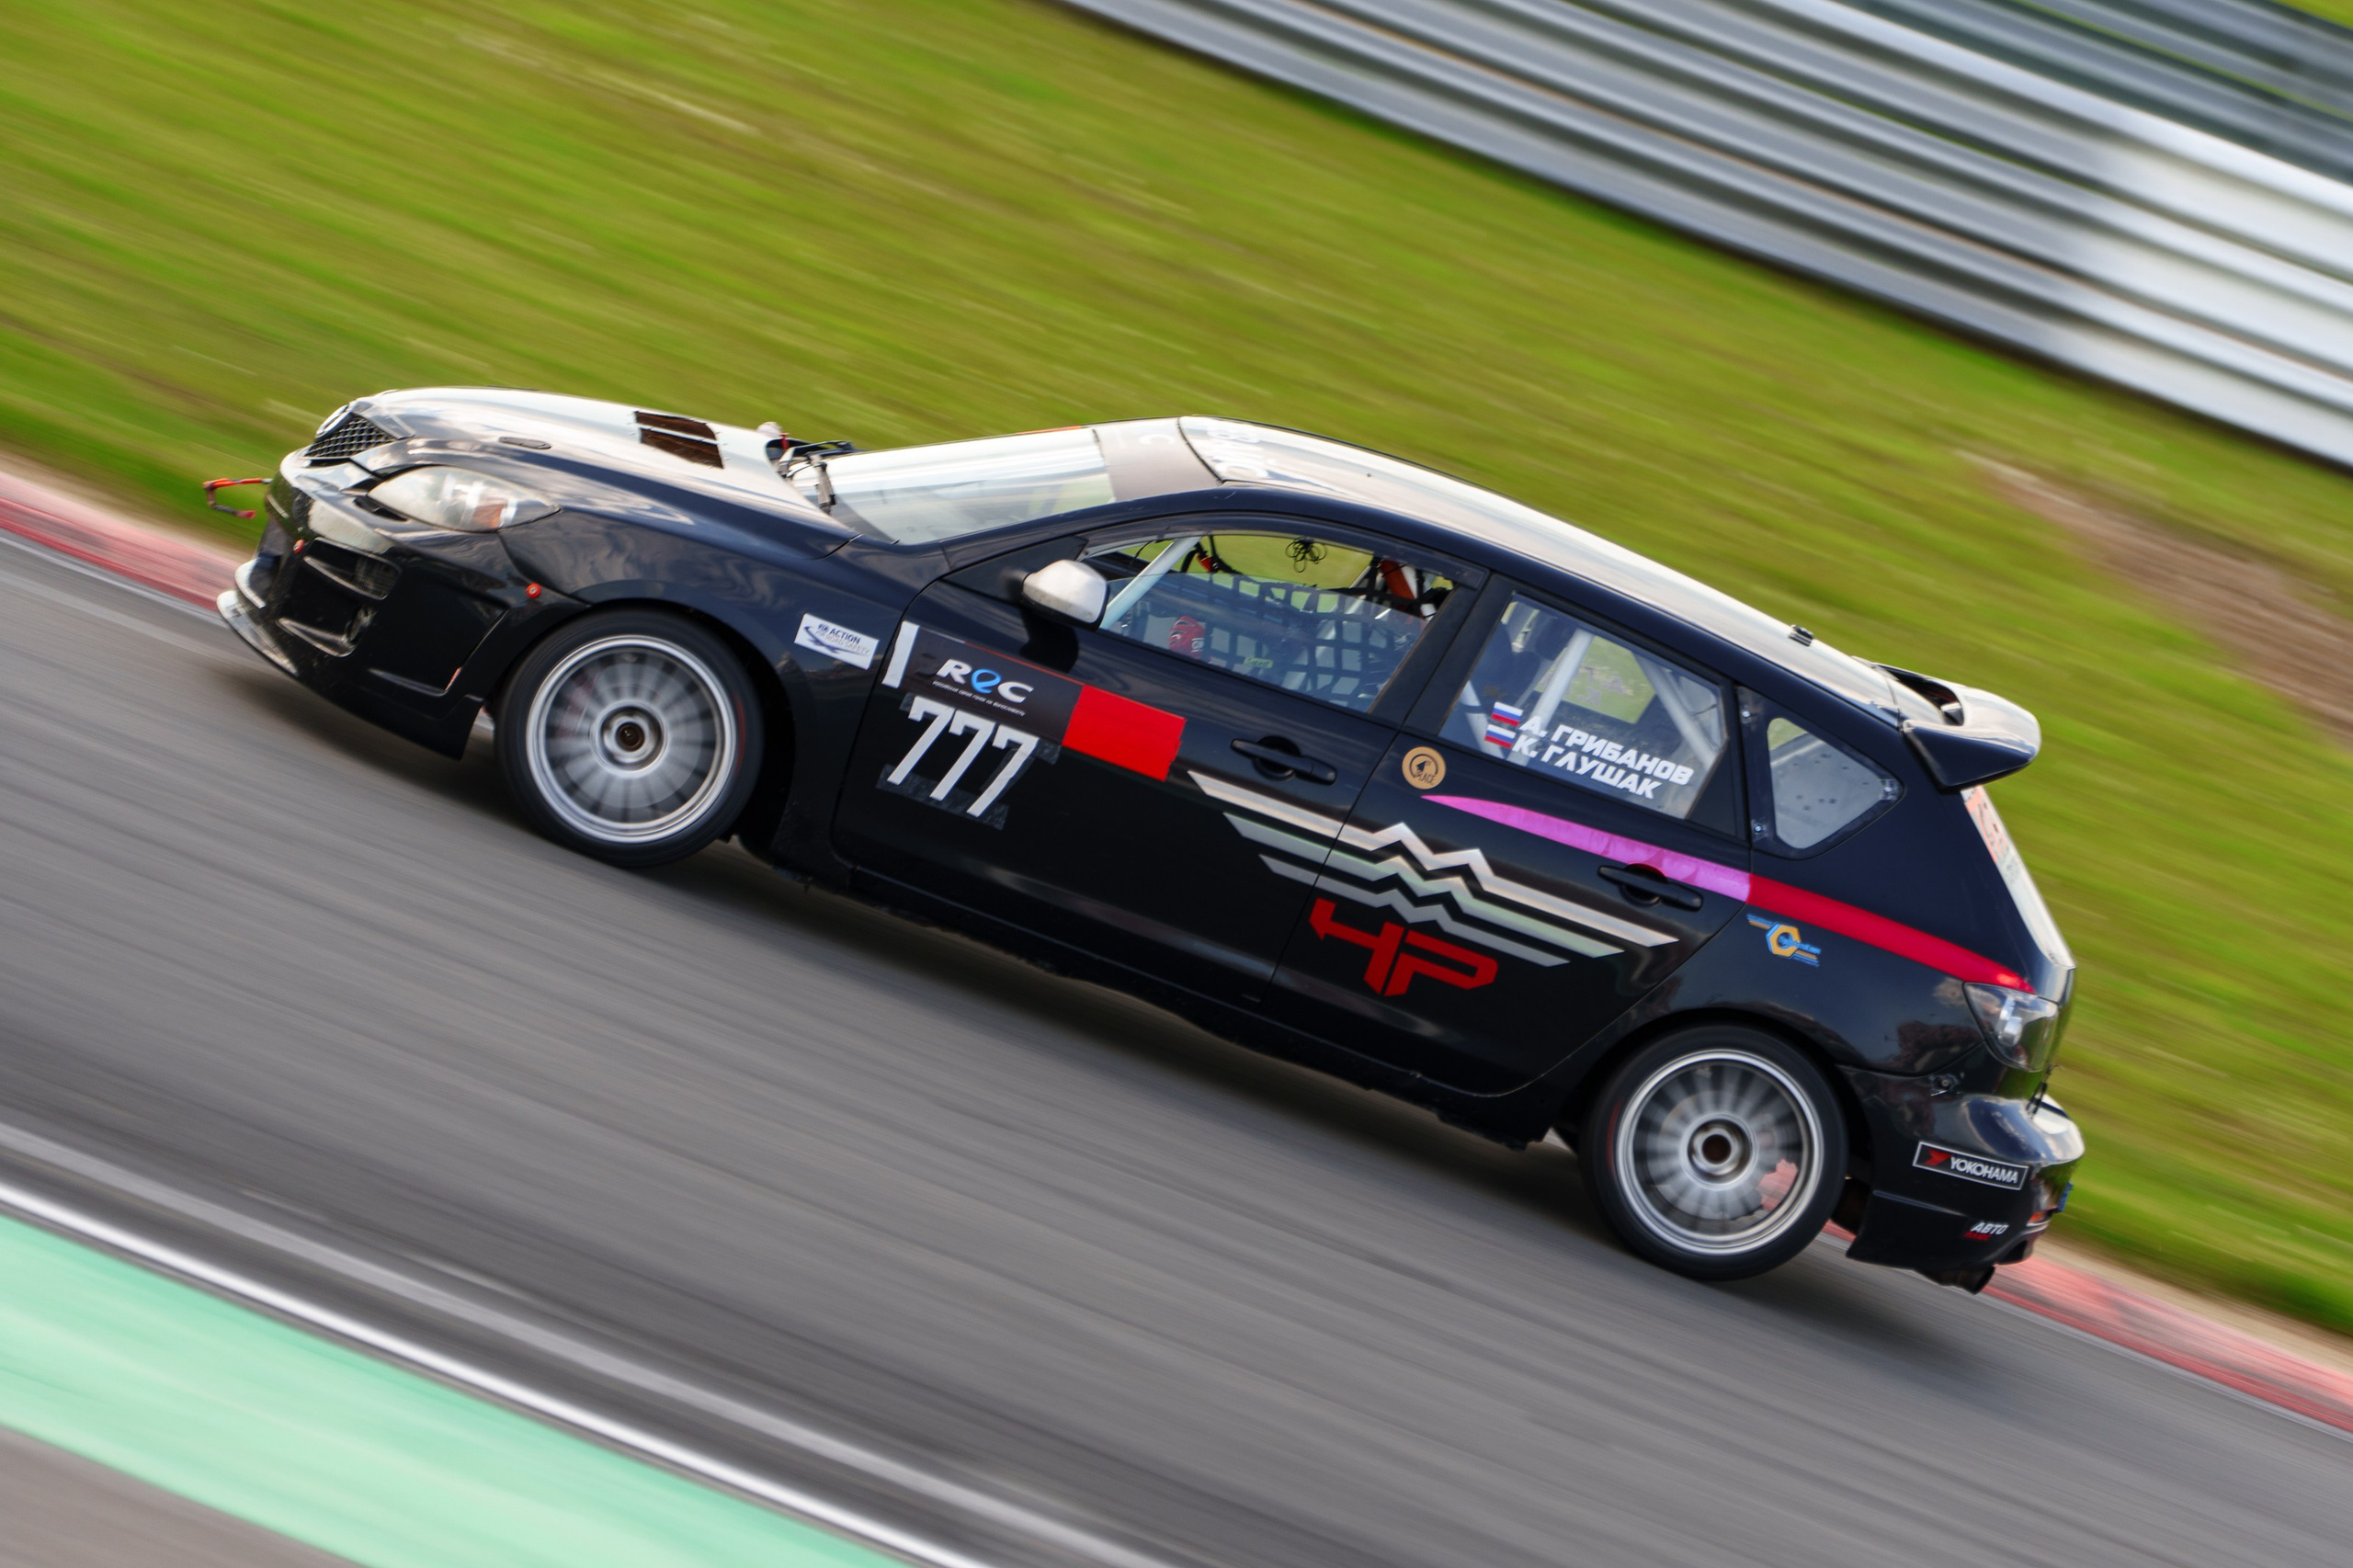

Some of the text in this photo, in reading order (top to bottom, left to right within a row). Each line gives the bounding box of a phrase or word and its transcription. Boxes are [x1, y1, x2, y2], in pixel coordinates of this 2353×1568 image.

[830, 628, 861, 644] ACTION
[886, 695, 1040, 817] 777
[1512, 734, 1662, 800] К. ГЛУШАК
[1518, 715, 1695, 785] А. ГРИБАНОВ
[1950, 1156, 2019, 1184] YOKOHAMA
